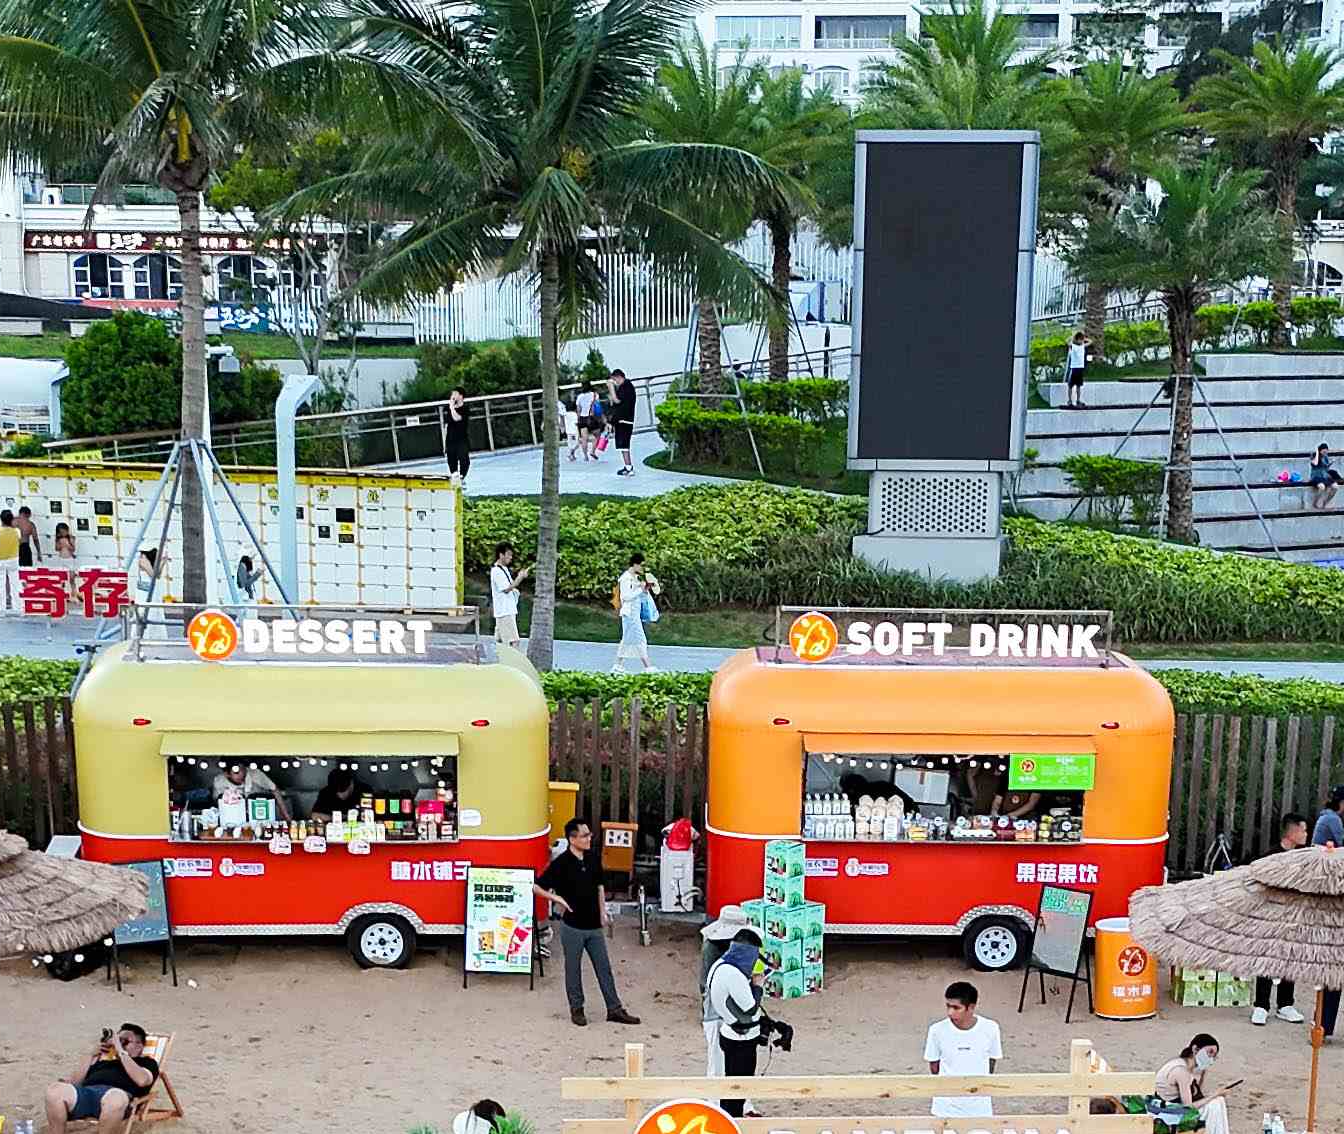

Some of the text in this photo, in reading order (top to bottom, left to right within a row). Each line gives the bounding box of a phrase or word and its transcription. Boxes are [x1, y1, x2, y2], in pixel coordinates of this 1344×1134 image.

[18, 567, 131, 619] 寄存
[242, 618, 433, 655] DESSERT
[846, 621, 1102, 658] SOFT DRINK
[1017, 863, 1098, 883] 果蔬果饮
